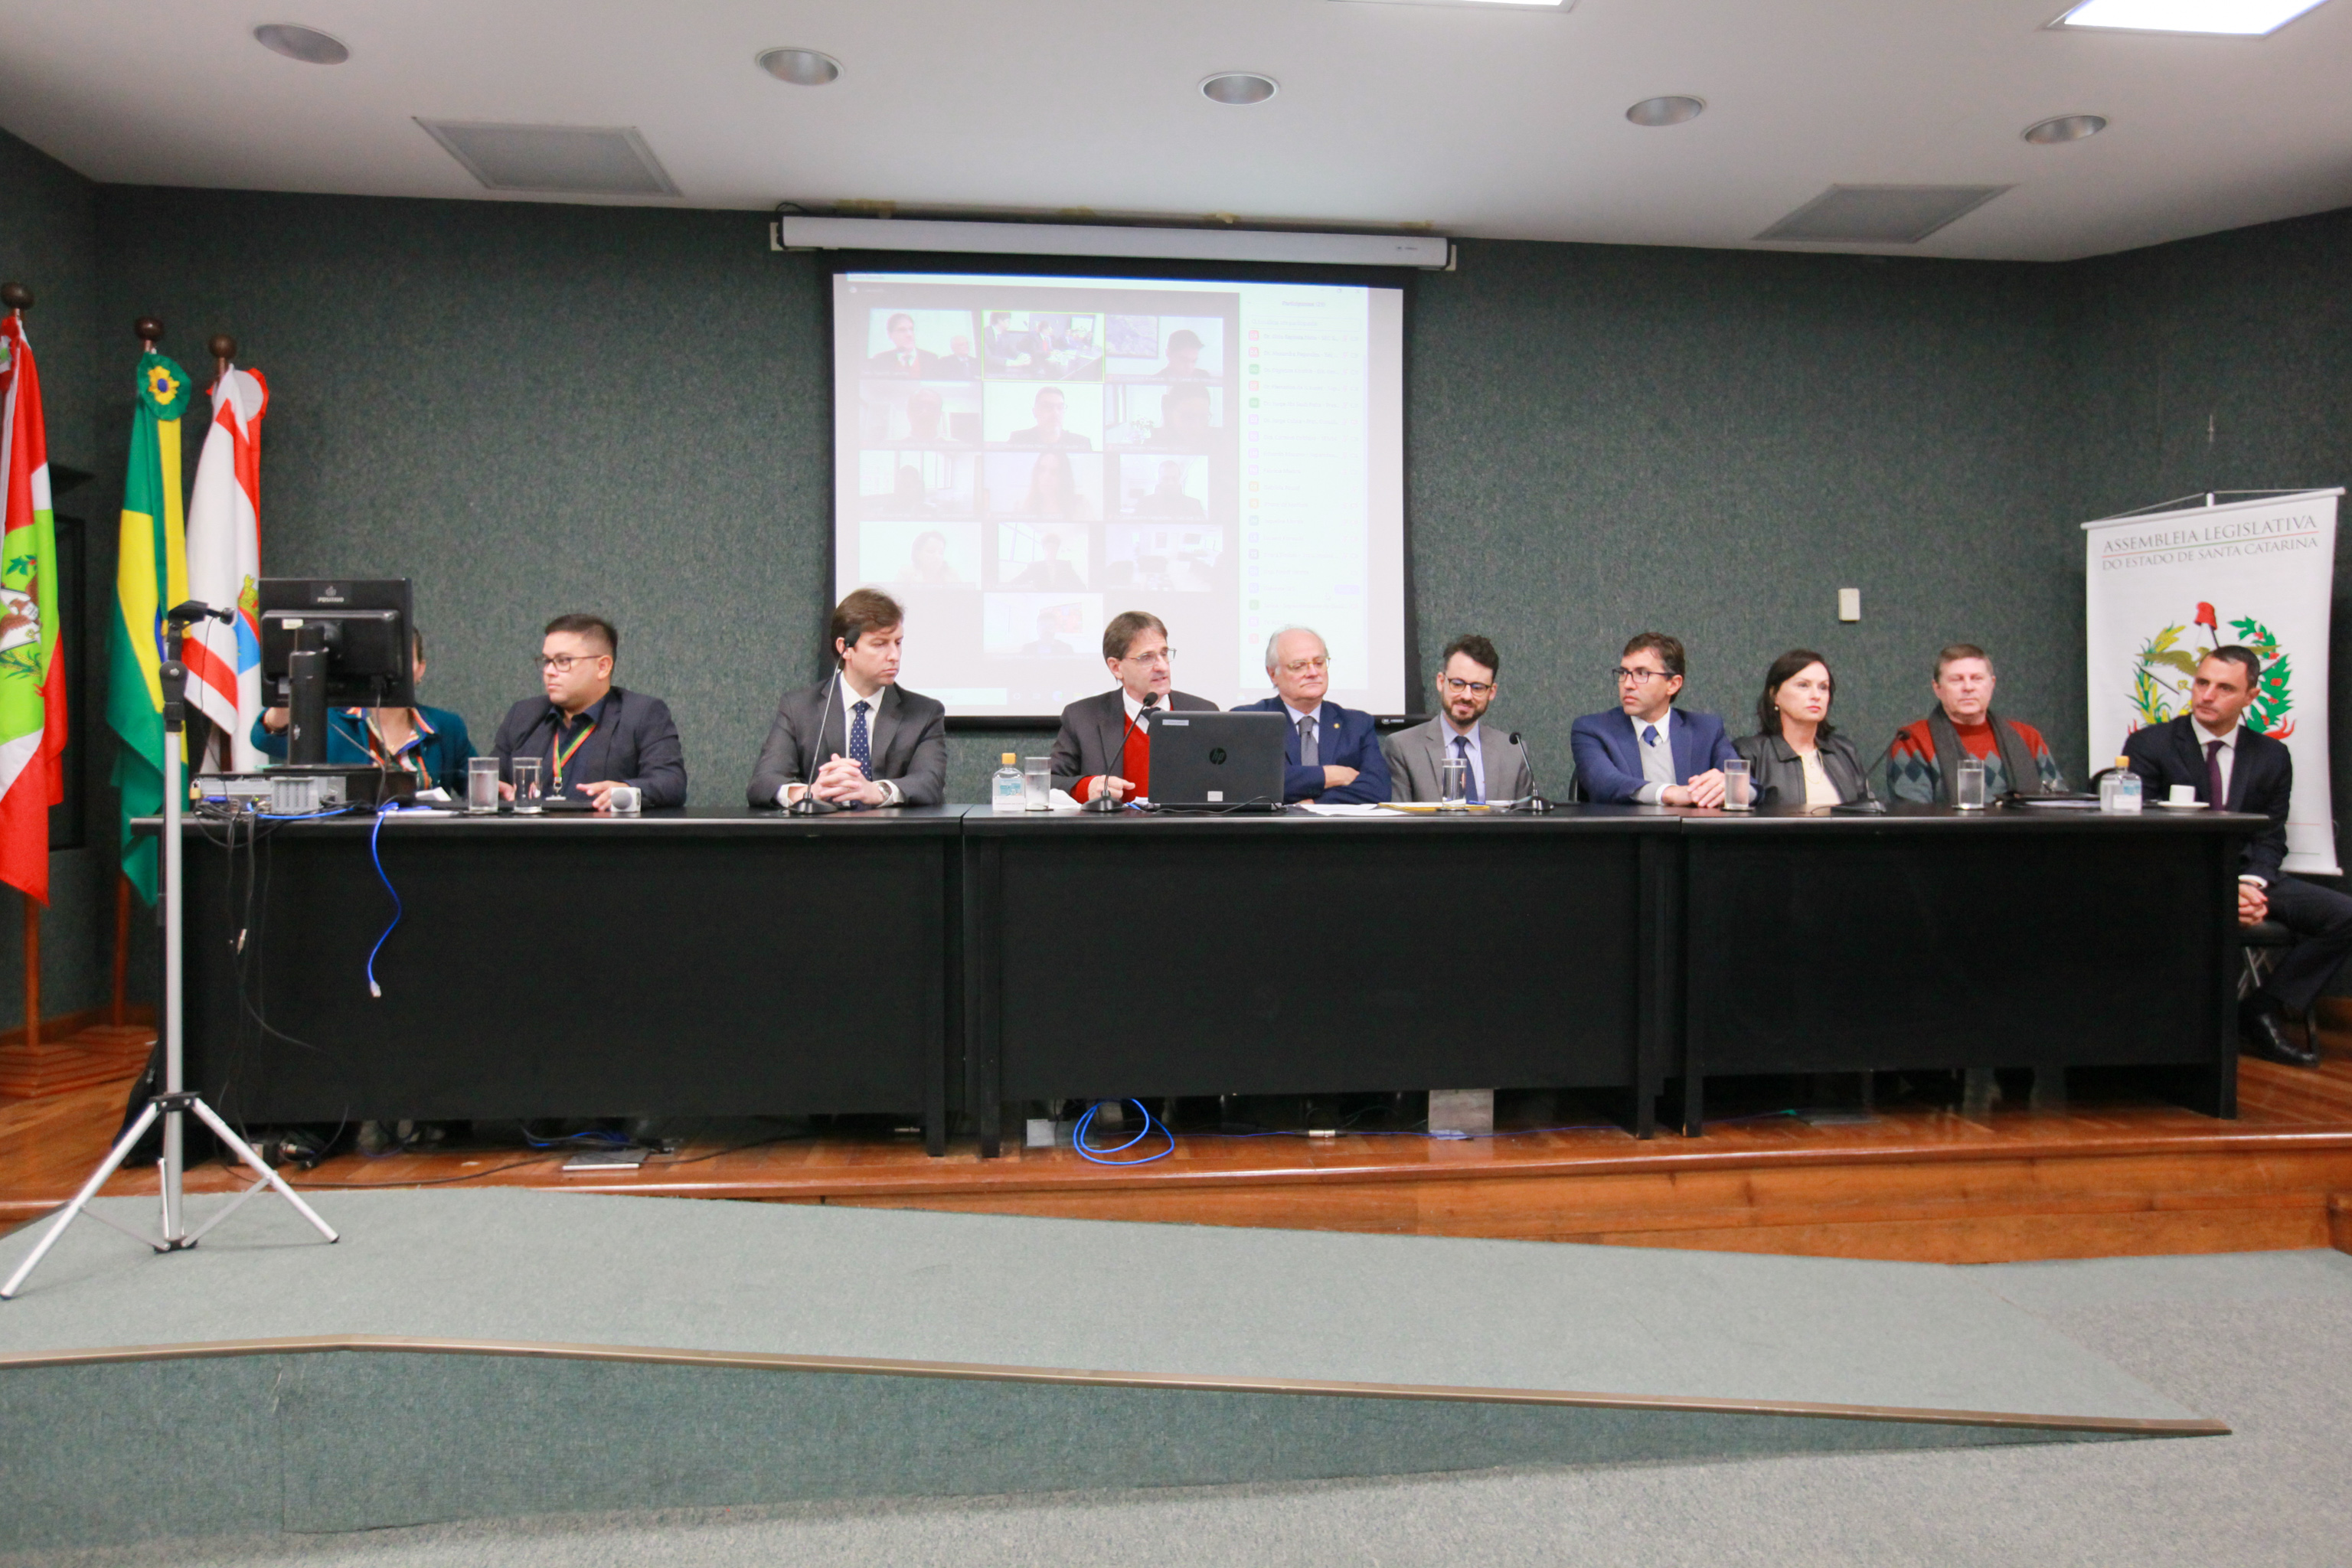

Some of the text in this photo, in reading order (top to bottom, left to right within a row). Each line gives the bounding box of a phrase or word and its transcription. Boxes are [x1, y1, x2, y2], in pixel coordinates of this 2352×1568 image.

[2102, 514, 2317, 553] ASSEMBLEIA LEGISLATIVA
[2102, 537, 2318, 570] DO ESTADO DE SANTA CATARINA
